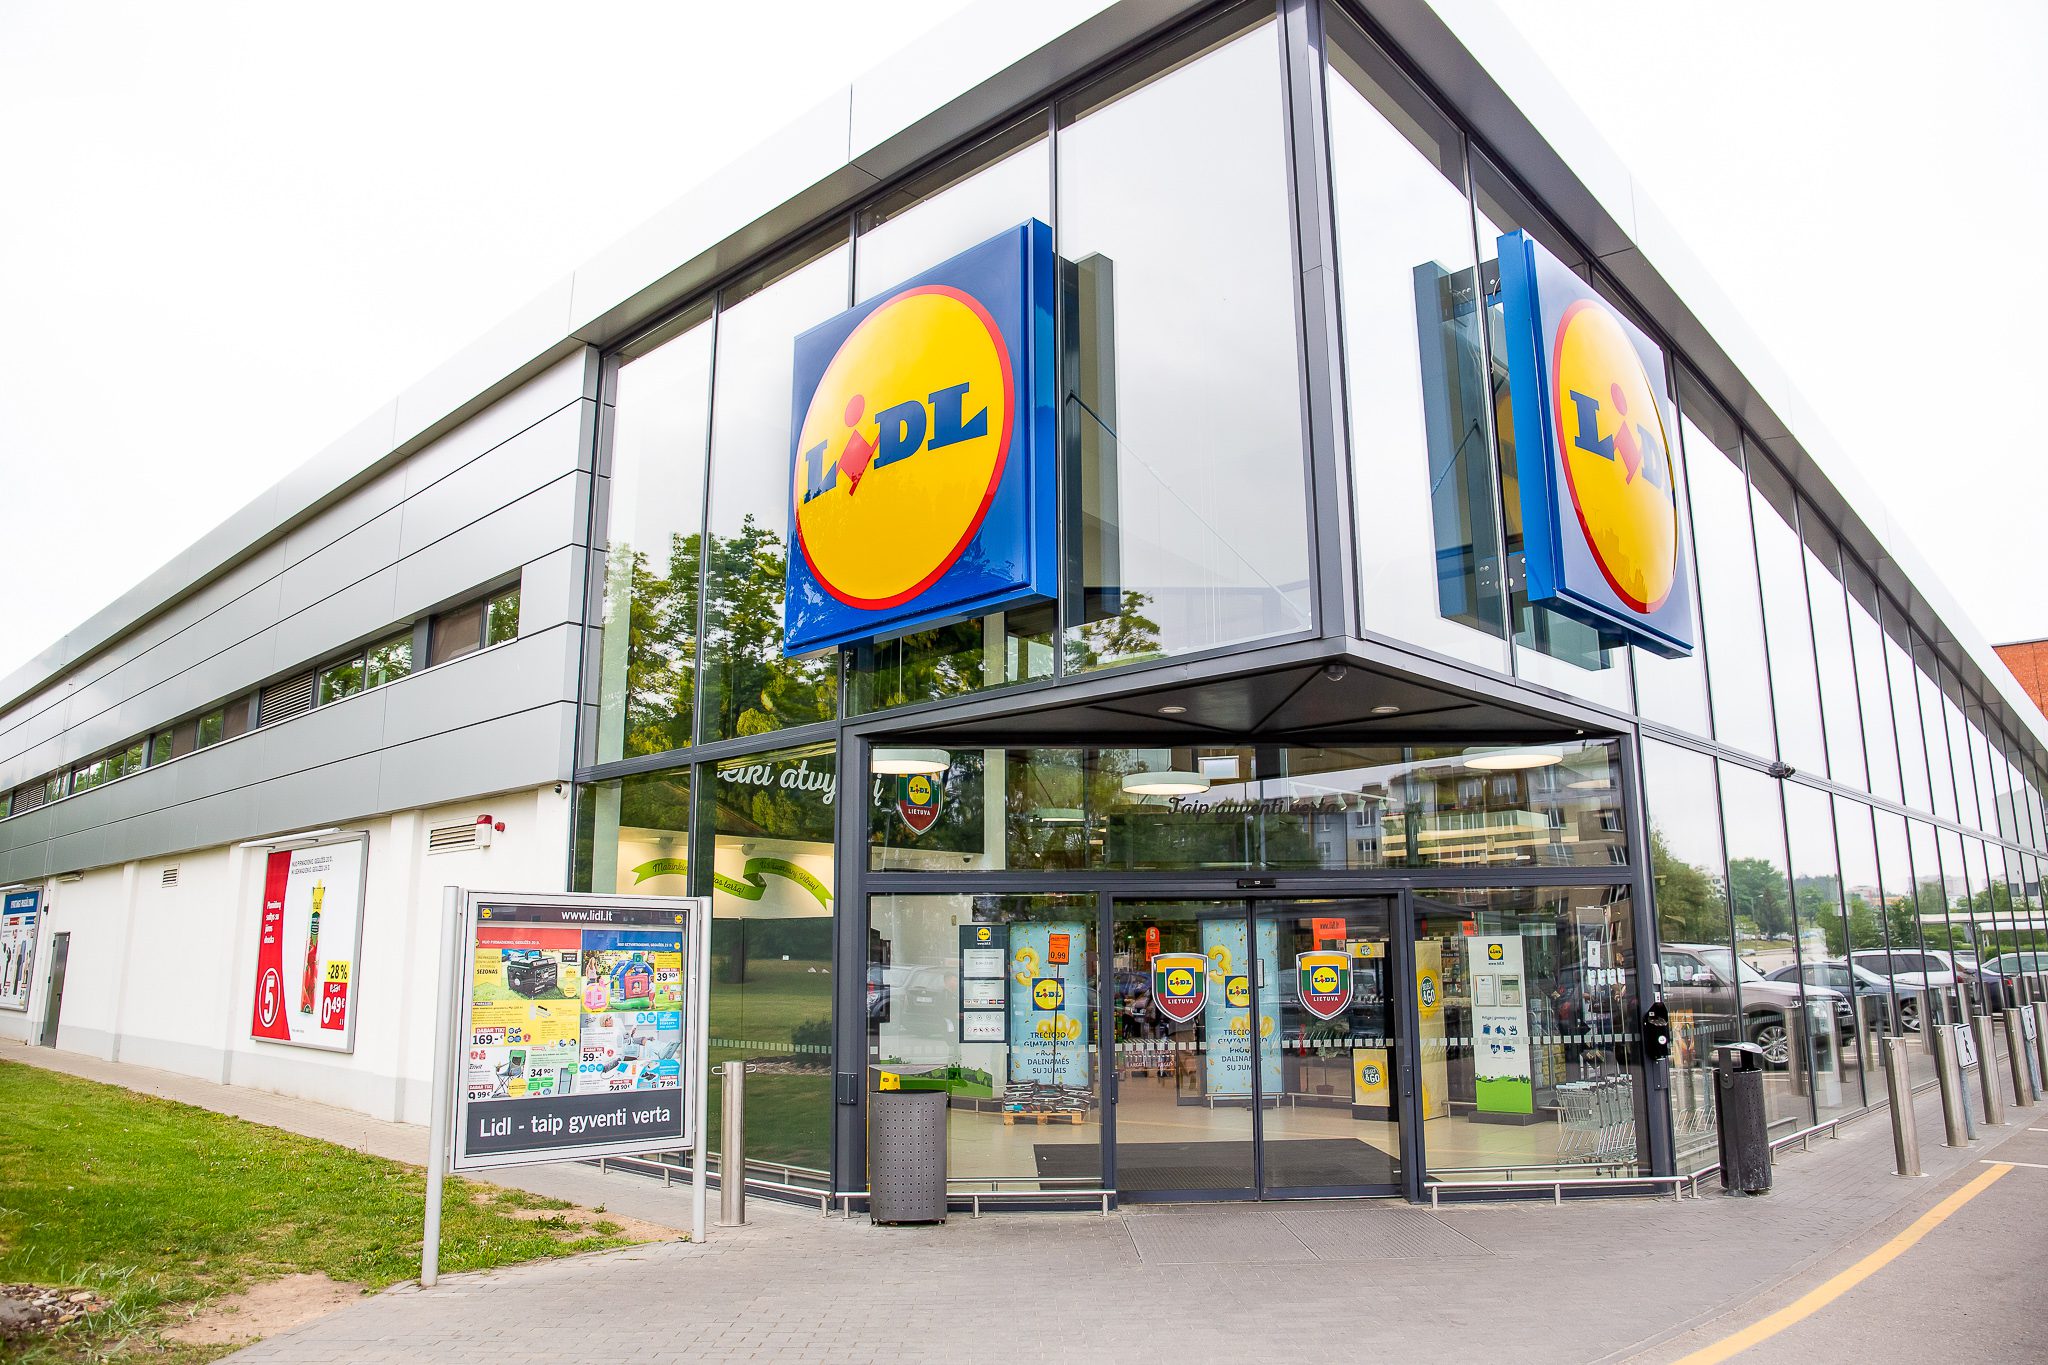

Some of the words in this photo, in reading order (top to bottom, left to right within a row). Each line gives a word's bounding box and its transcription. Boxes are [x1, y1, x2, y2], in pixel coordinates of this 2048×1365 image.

[780, 759, 836, 805] atvy
[908, 808, 931, 816] LIETUVA
[1167, 796, 1211, 821] Taip
[561, 910, 613, 922] www.lidl.lt
[263, 975, 275, 1023] 5
[530, 1069, 542, 1078] 34
[480, 1116, 512, 1138] Lidl
[531, 1113, 563, 1136] taip
[568, 1108, 626, 1134] gyventi
[631, 1106, 670, 1124] verta
